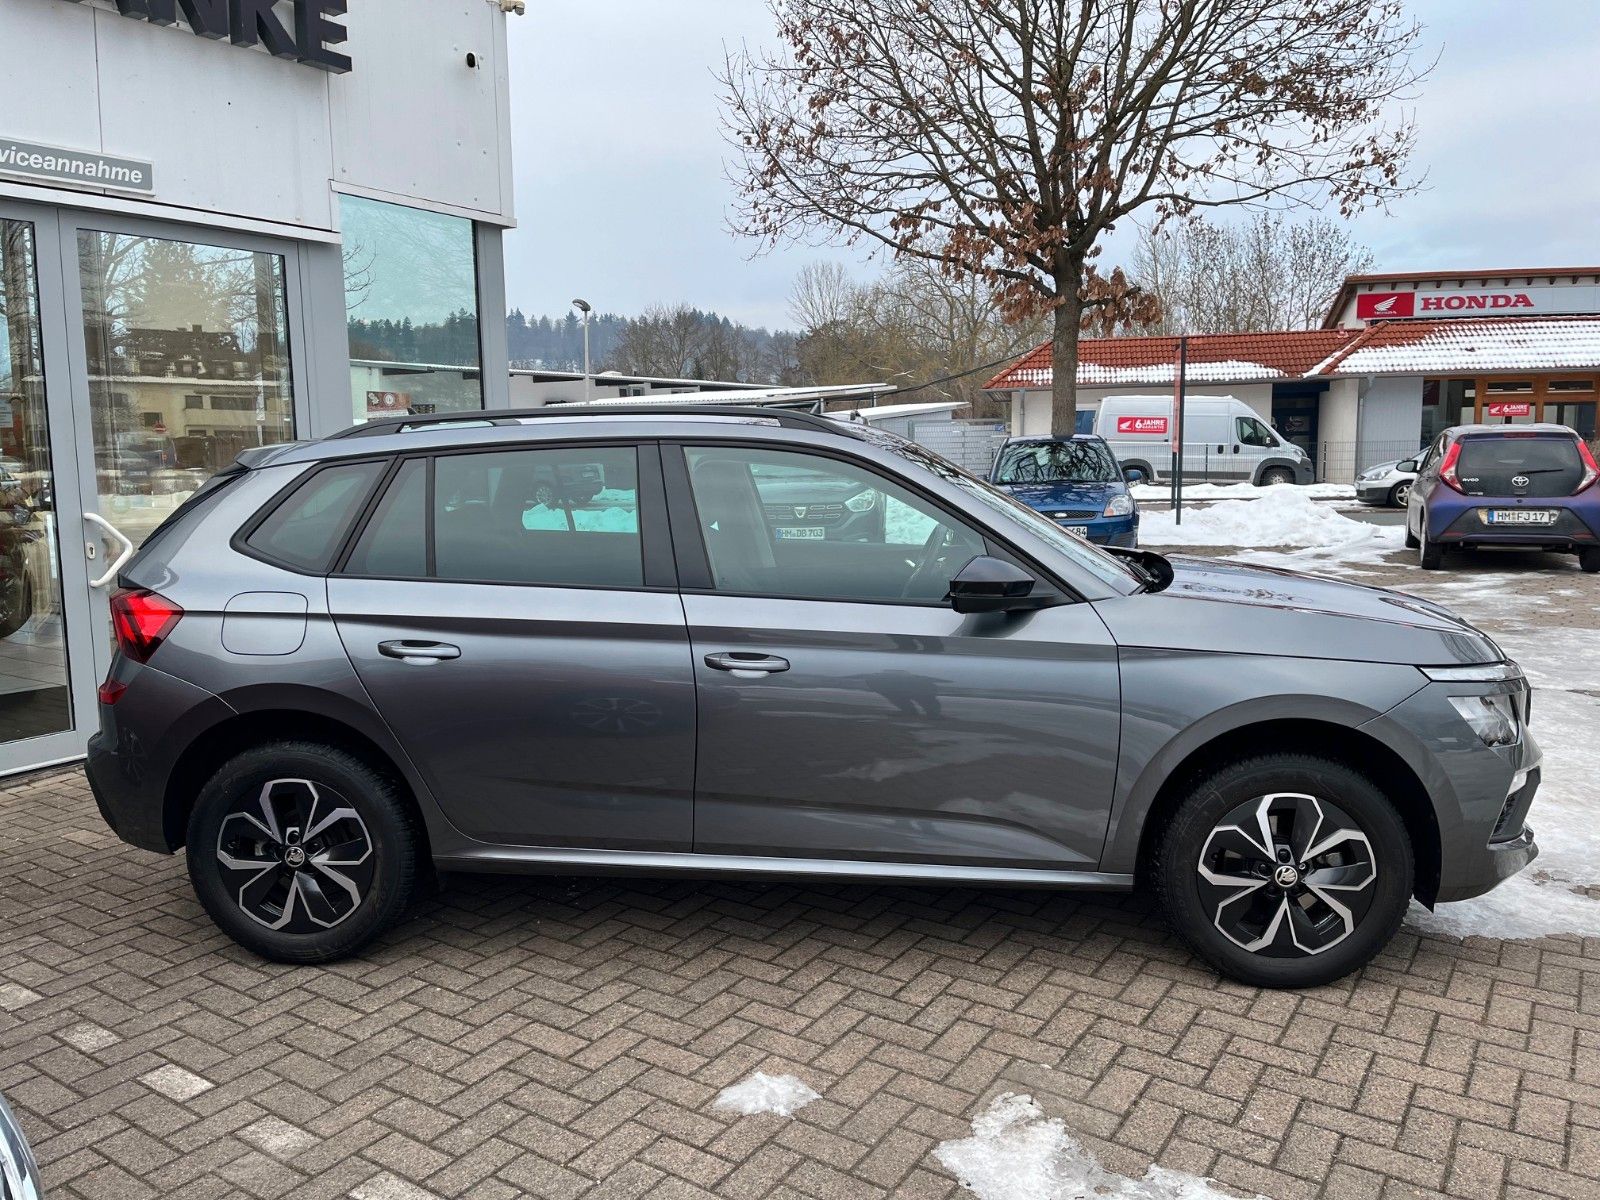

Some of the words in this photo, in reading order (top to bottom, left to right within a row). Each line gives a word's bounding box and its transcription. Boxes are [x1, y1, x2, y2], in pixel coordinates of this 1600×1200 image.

[1421, 294, 1535, 311] HONDA
[1135, 419, 1143, 429] 6
[1497, 512, 1511, 521] HM
[1517, 512, 1531, 521] FJ
[1532, 512, 1545, 521] 17
